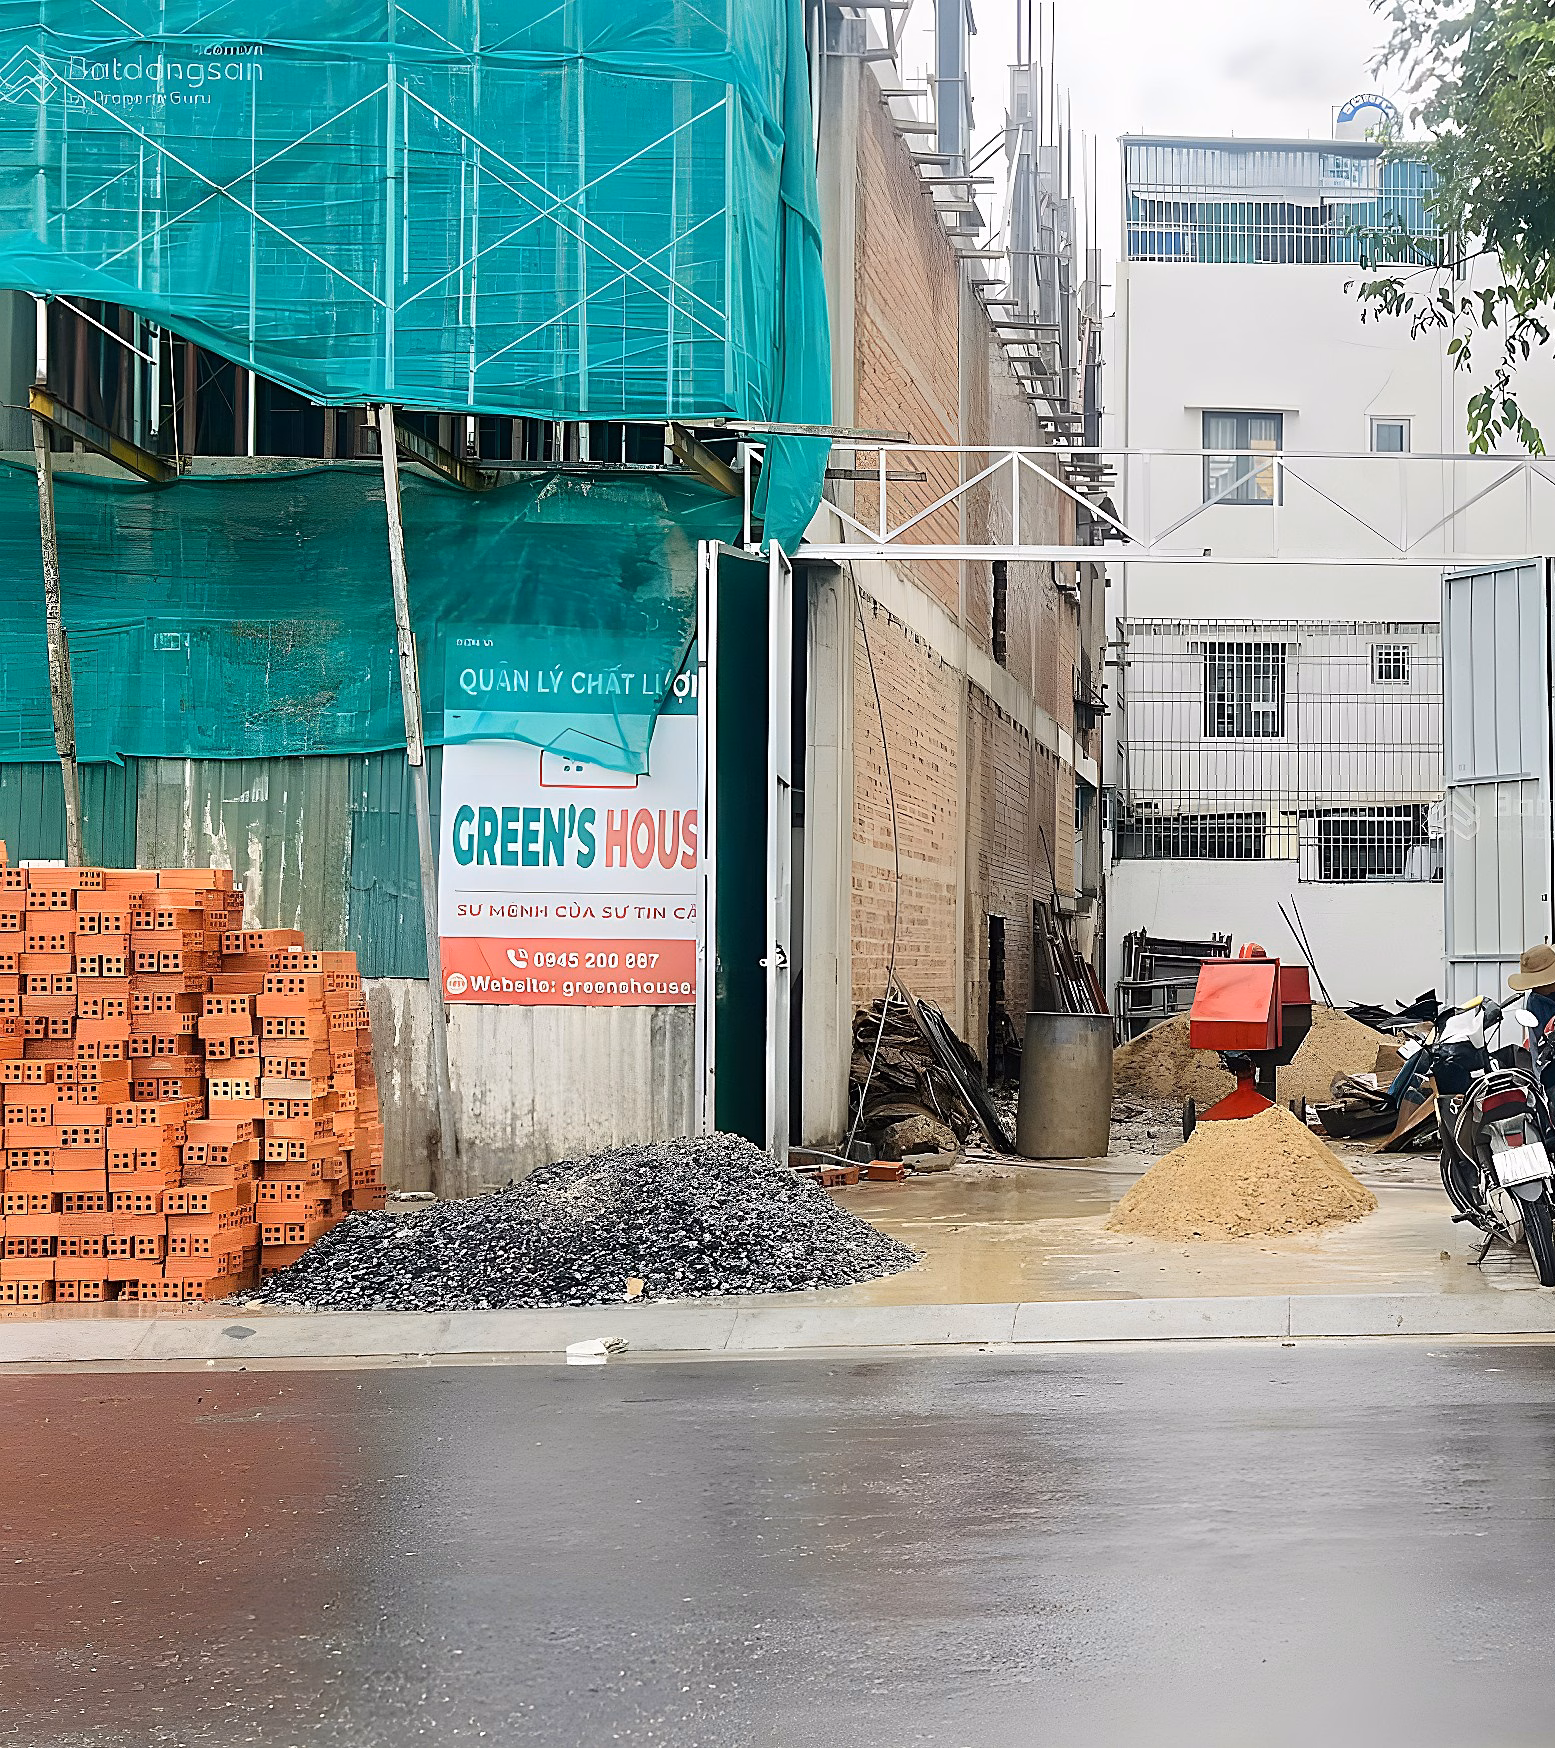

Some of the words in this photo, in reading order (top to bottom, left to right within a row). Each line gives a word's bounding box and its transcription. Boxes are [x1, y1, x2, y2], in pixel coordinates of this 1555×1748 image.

[537, 663, 564, 694] LÝ
[452, 803, 597, 869] GREEN'S
[585, 952, 619, 969] 200
